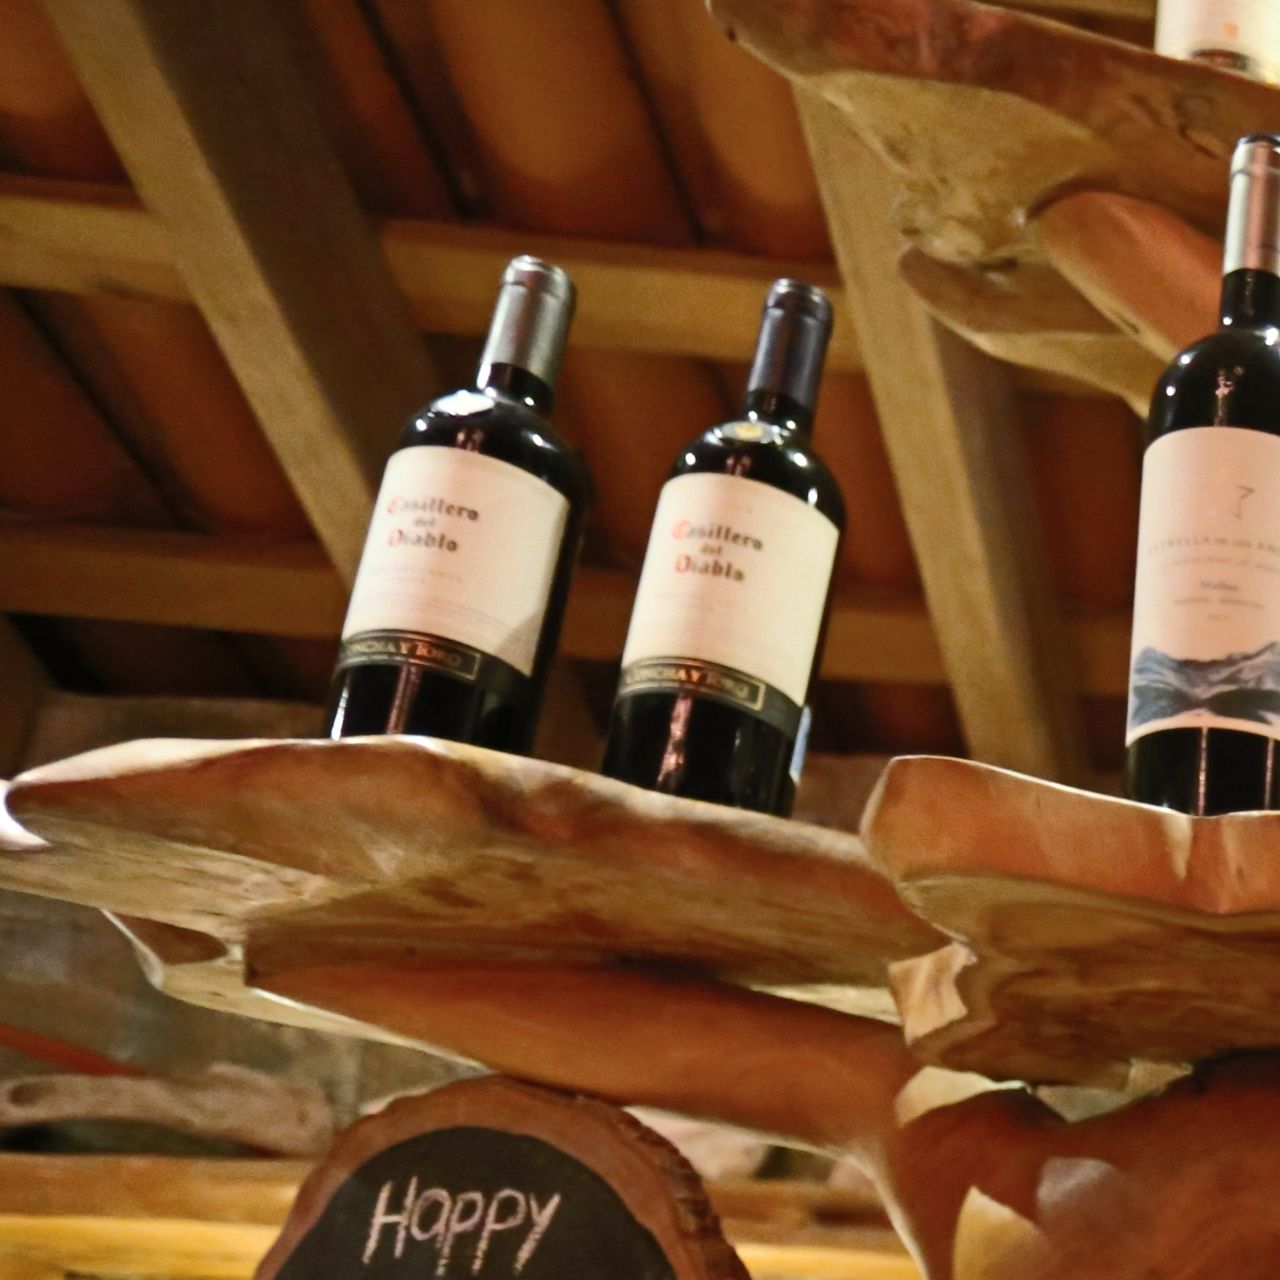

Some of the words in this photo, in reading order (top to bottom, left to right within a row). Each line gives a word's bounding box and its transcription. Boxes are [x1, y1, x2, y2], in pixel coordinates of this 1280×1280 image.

[671, 518, 764, 550] Casillero
[675, 554, 745, 582] Diablo
[362, 1175, 561, 1277] Happy
